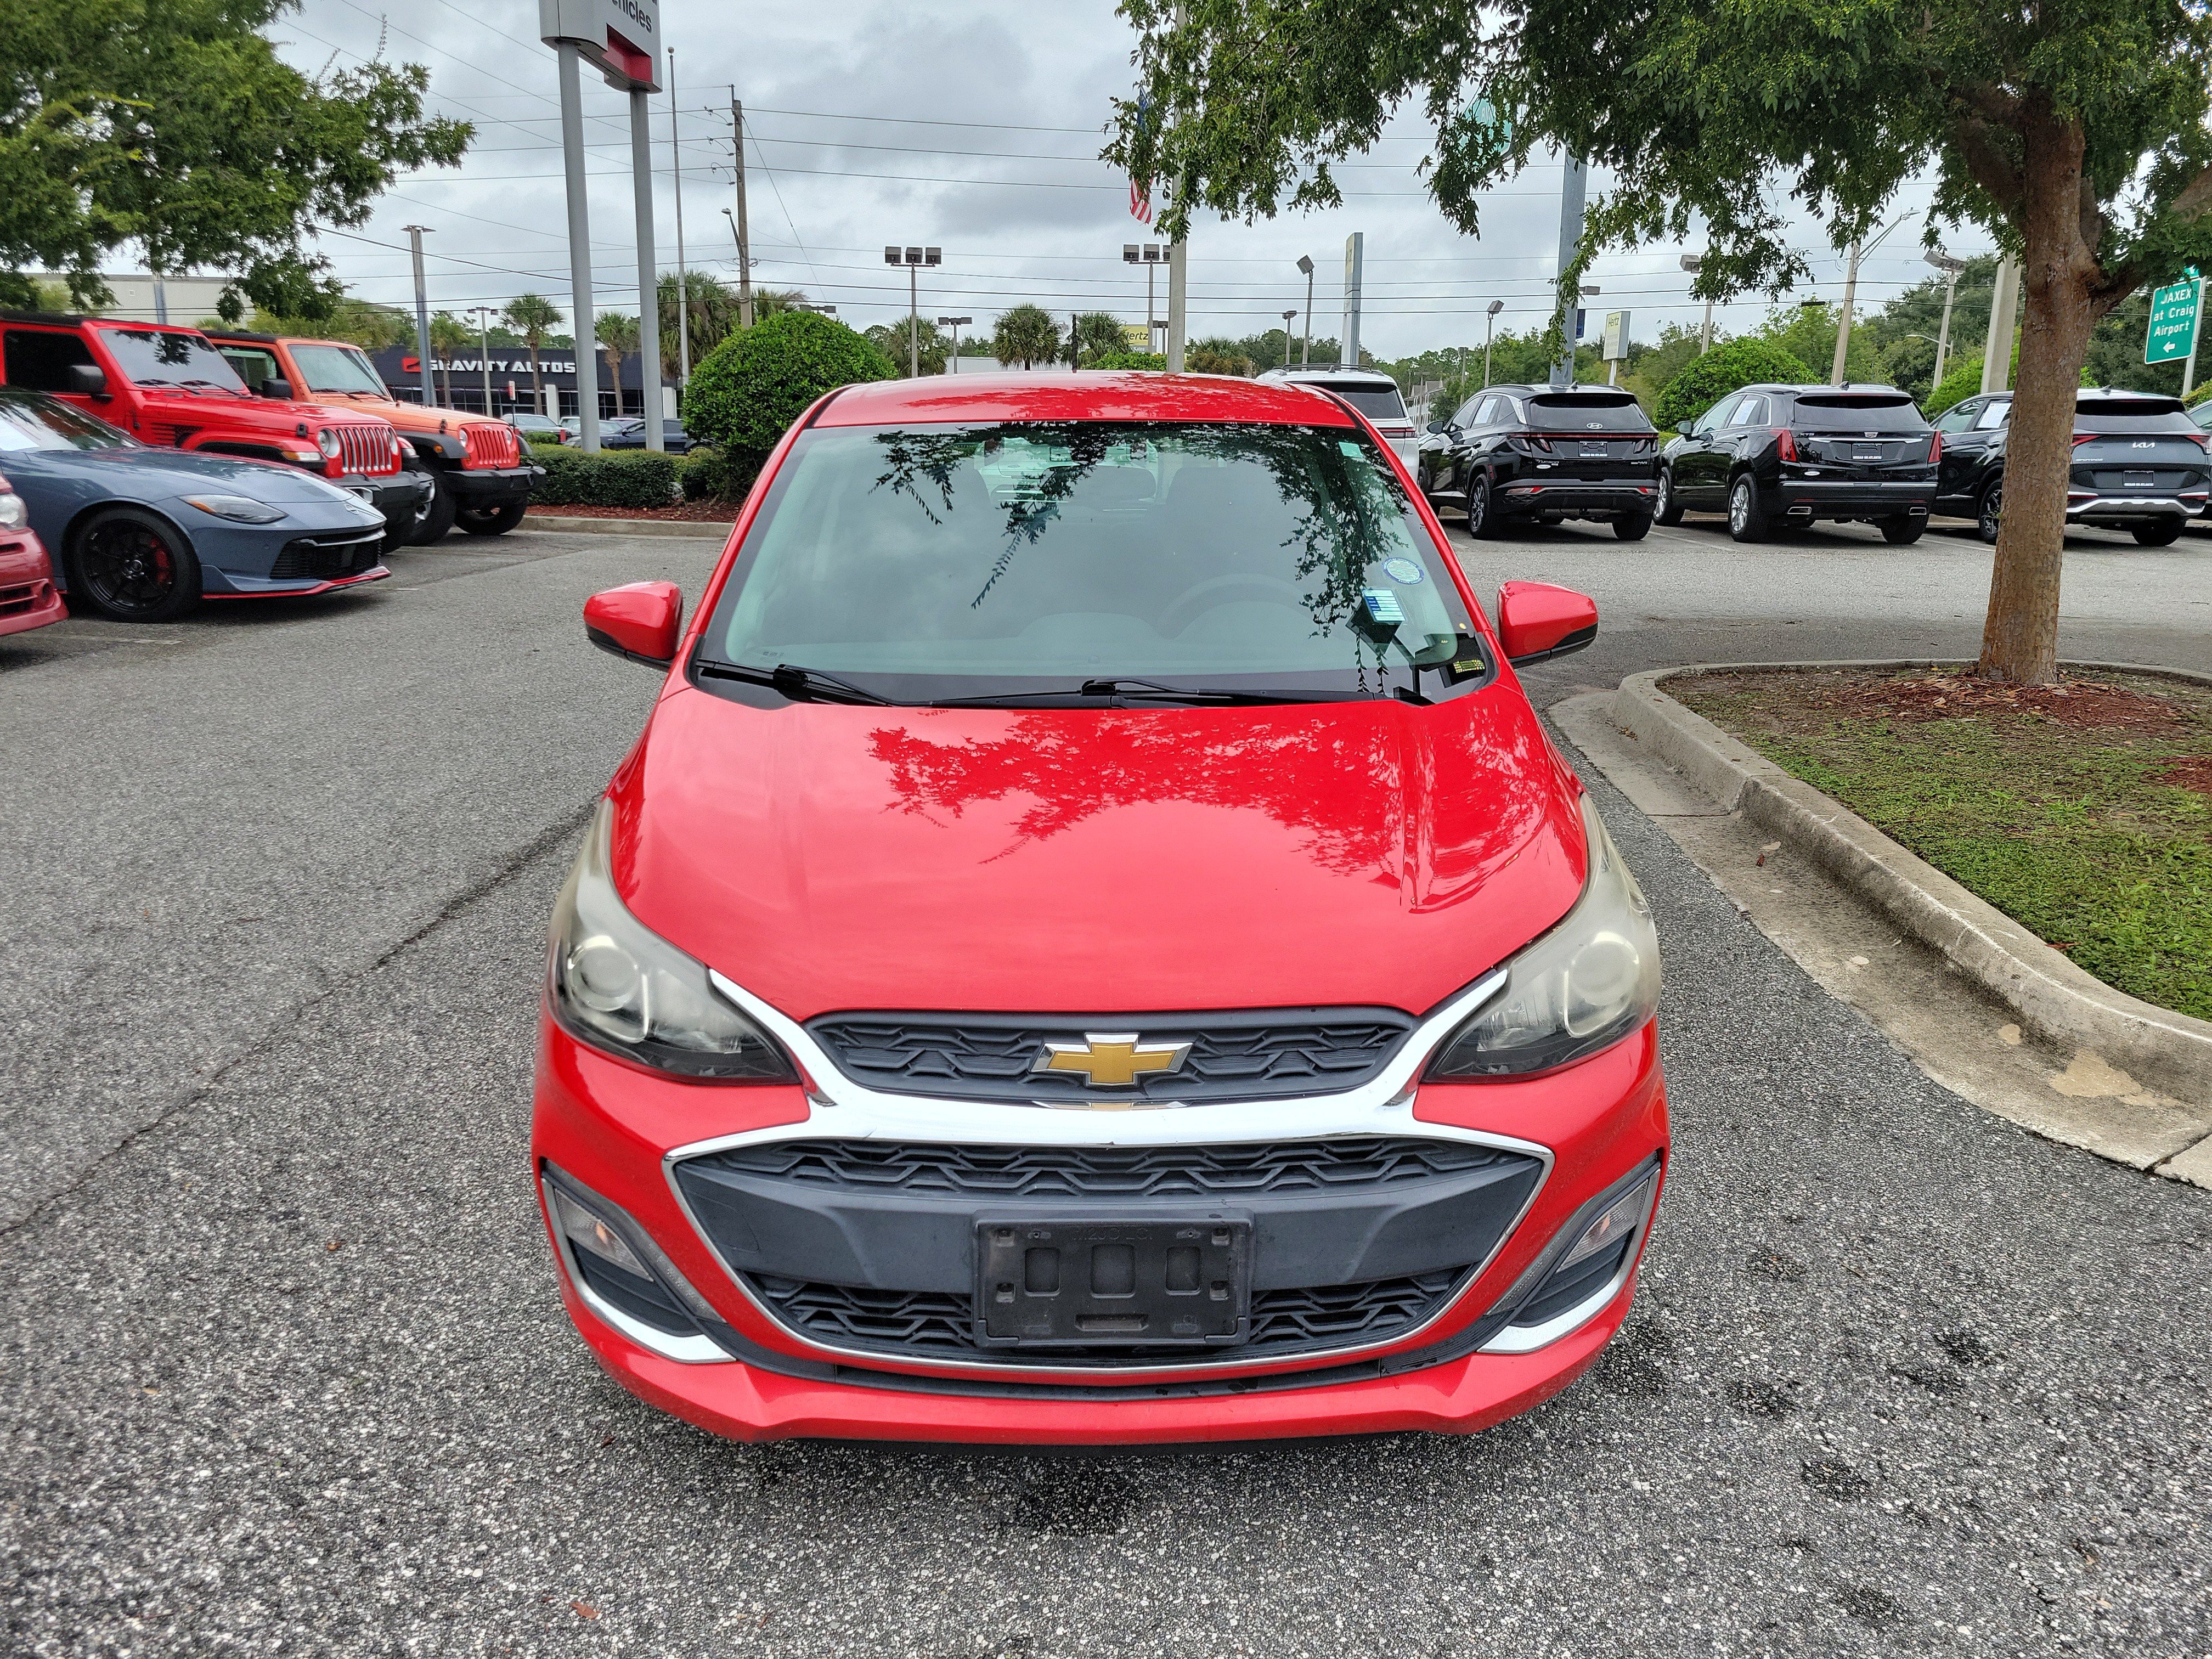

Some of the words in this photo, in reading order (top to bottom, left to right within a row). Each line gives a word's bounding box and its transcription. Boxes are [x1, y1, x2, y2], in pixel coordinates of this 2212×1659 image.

[2160, 288, 2192, 304] JAXEX
[2154, 310, 2164, 321] at
[2169, 304, 2194, 318] Craig
[1126, 331, 1148, 340] ertz
[2154, 320, 2190, 337] Airport
